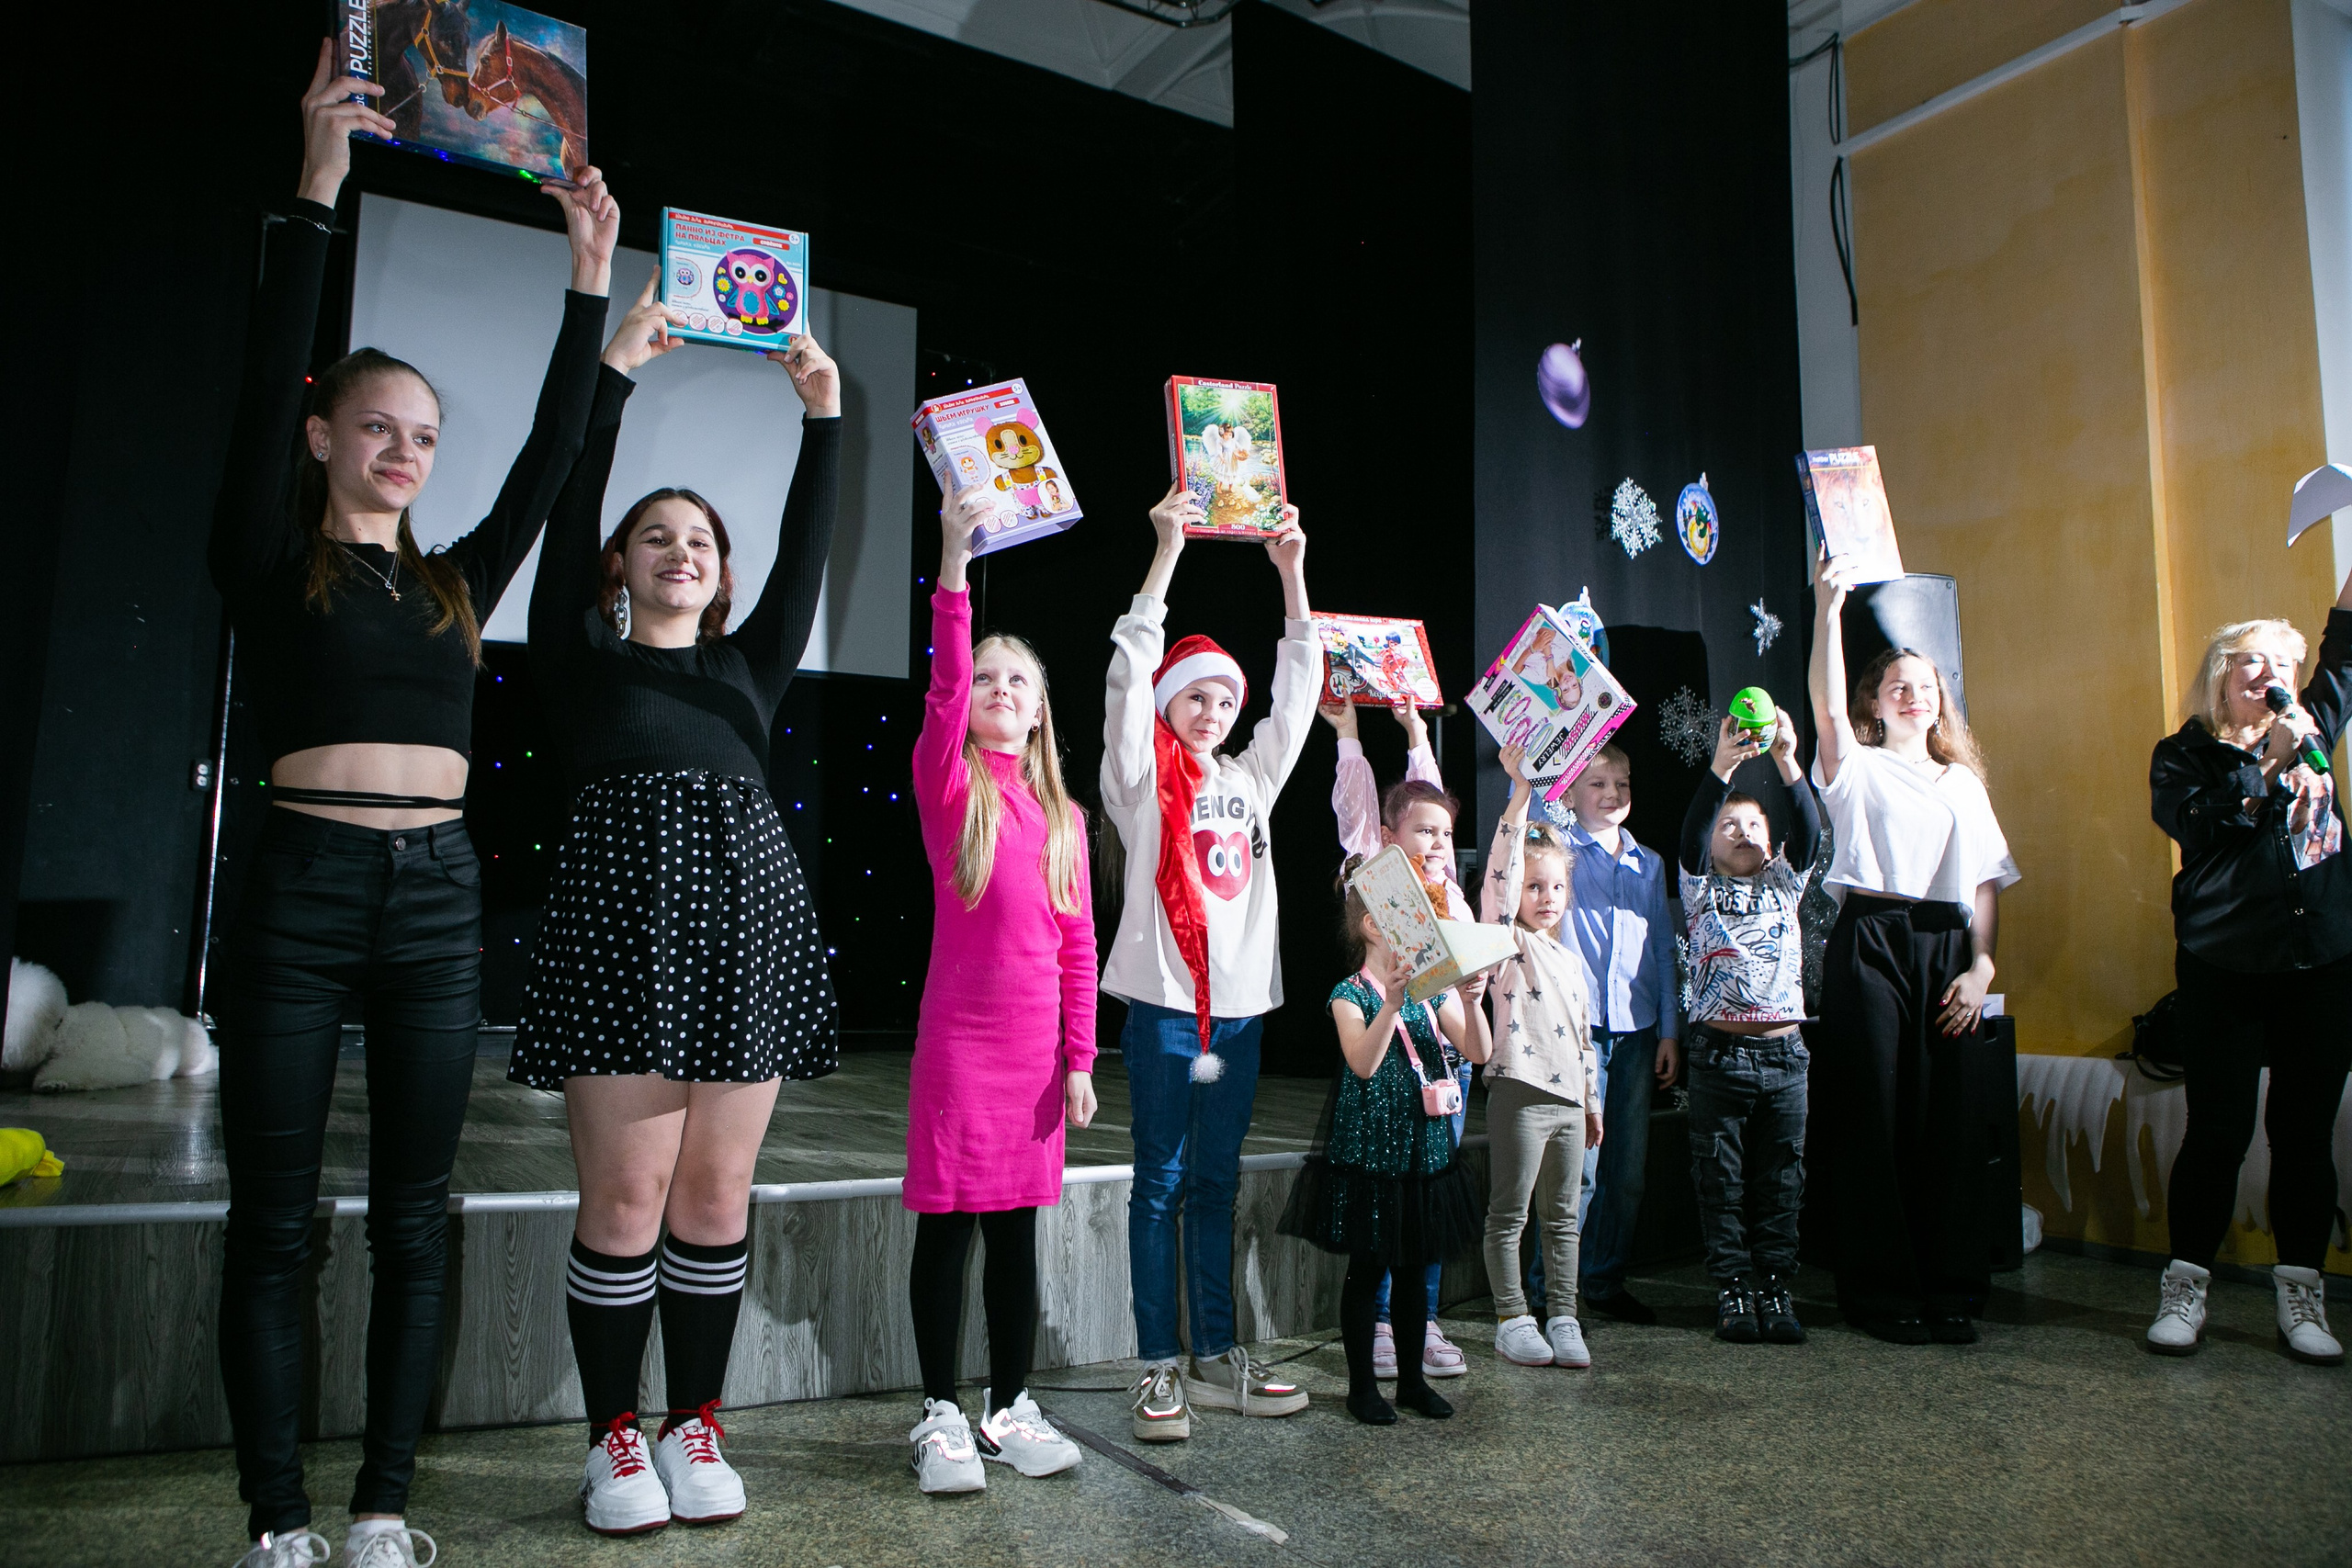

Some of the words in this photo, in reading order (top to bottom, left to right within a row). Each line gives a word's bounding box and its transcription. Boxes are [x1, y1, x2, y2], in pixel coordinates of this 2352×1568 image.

[349, 0, 368, 74] PUZZLE
[675, 223, 703, 233] ПАННО
[718, 231, 745, 242] ФЕТРА
[688, 233, 726, 245] ПЯЛЬЦАХ
[1198, 379, 1233, 389] Castorland
[935, 412, 956, 423] ШЬЕМ
[957, 404, 989, 418] ИГРУШКУ
[1562, 712, 1591, 751] MUSIC
[1538, 732, 1565, 767] JEWELRY
[1714, 888, 1780, 914] POSITIVE
